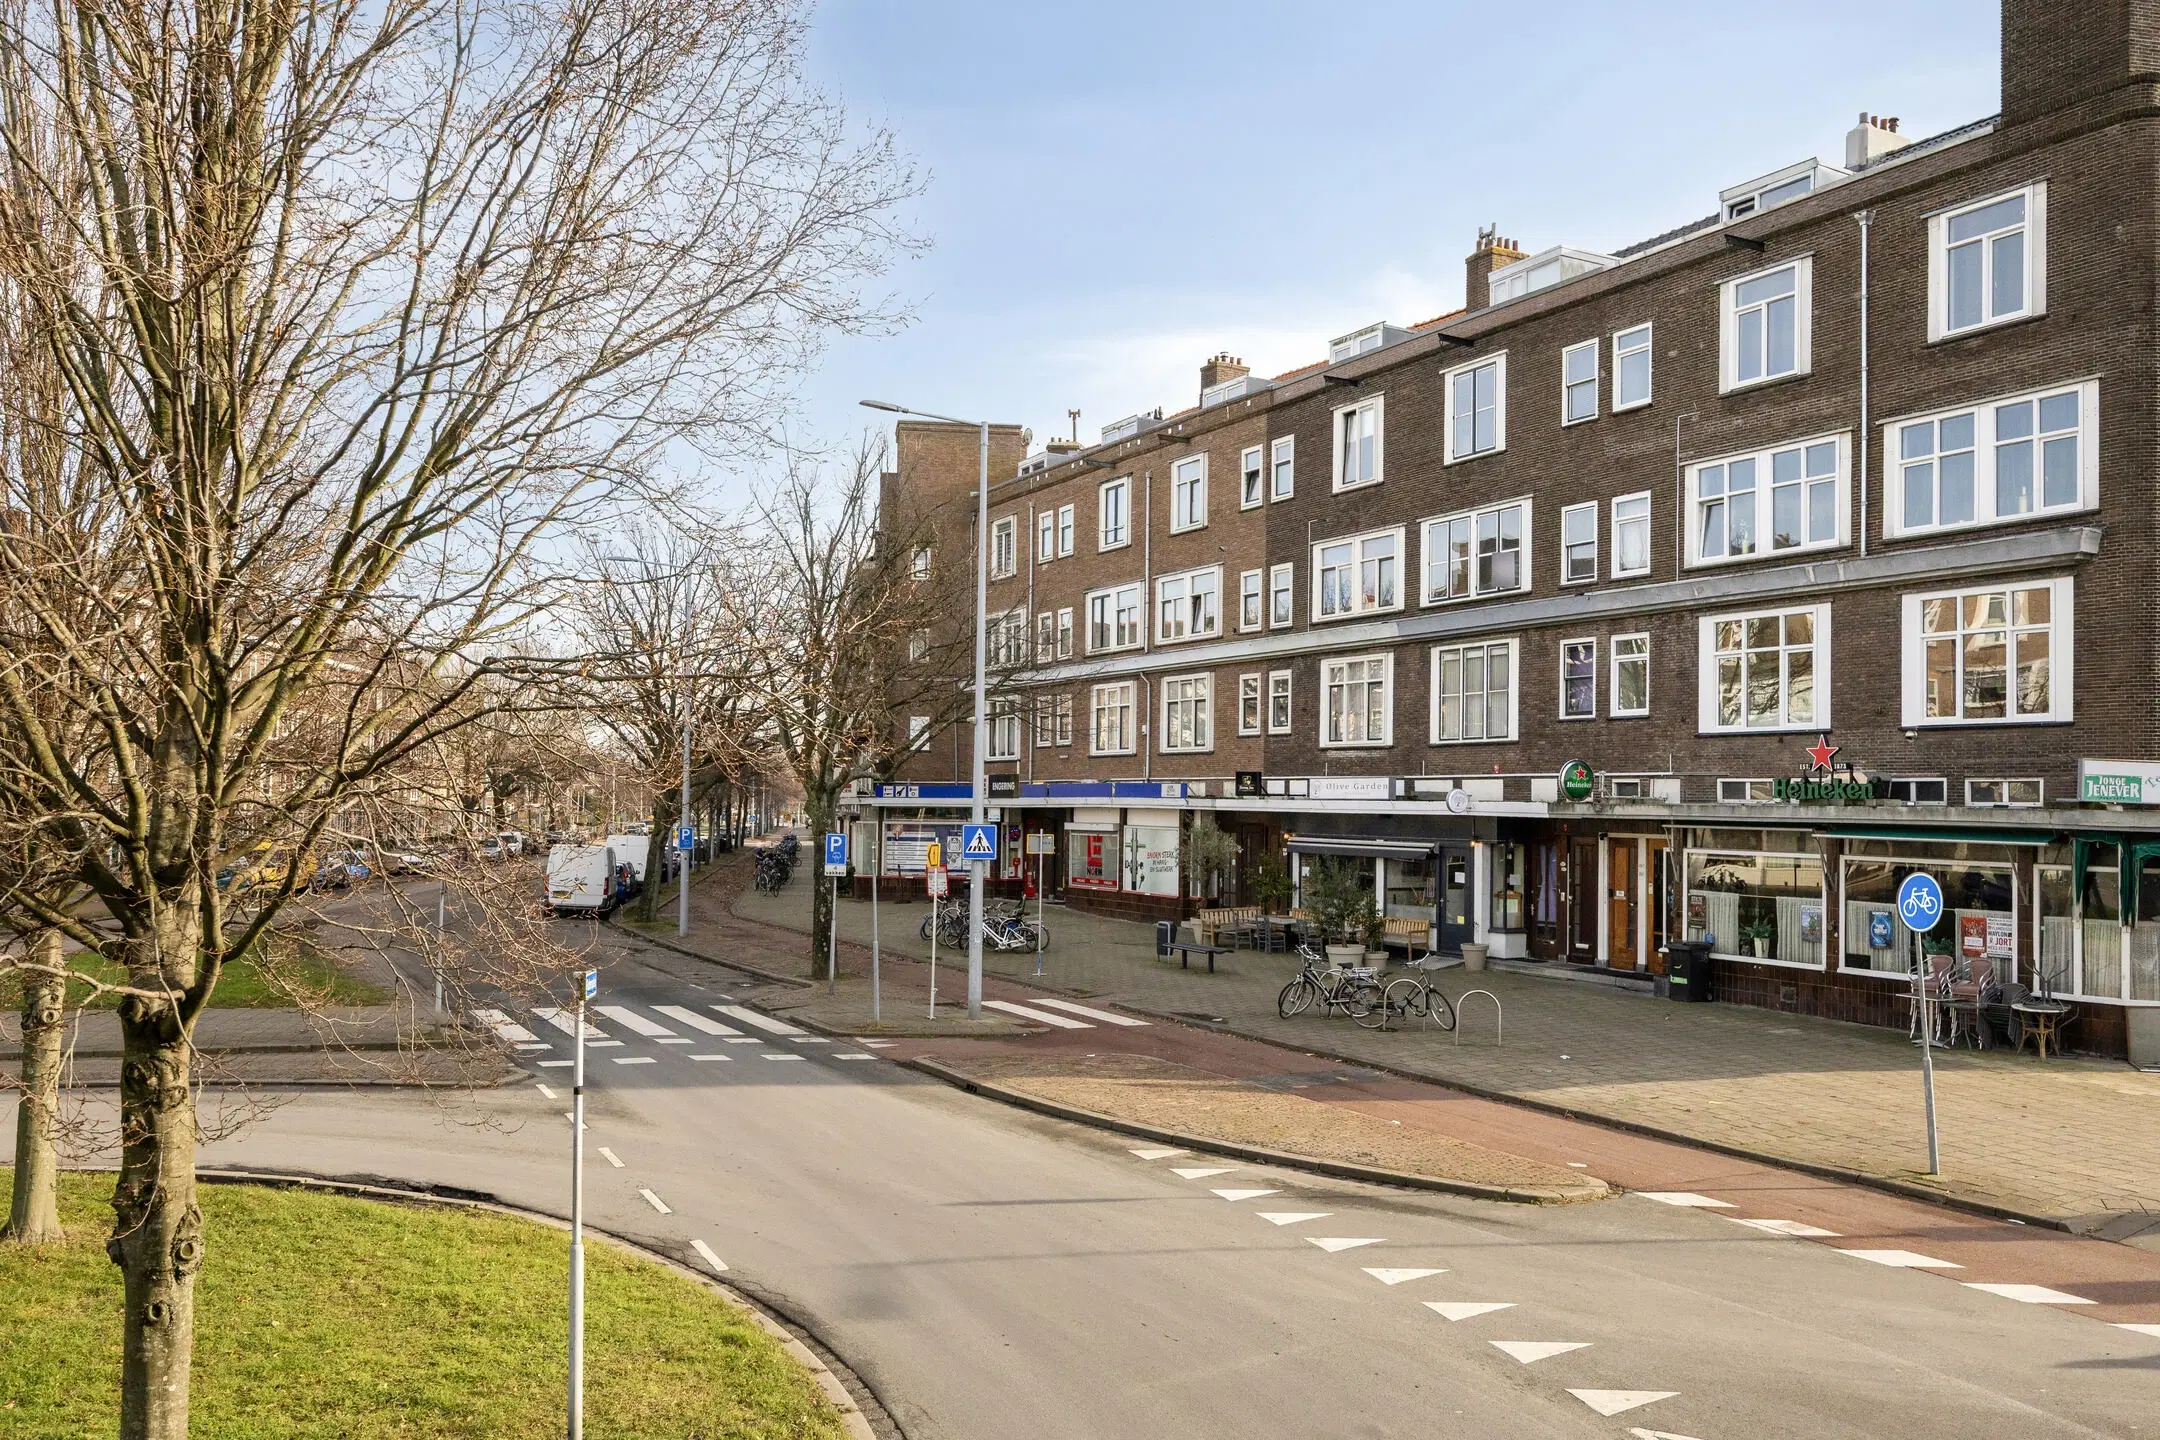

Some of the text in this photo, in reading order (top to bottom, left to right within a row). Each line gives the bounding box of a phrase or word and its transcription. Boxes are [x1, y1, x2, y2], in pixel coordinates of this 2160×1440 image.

[992, 781, 1016, 791] ENGERING
[1325, 782, 1388, 791] Olive Garden
[1773, 776, 1874, 801] Heineken
[2086, 779, 2140, 798] JENEVER
[682, 828, 691, 841] P
[830, 836, 843, 853] P
